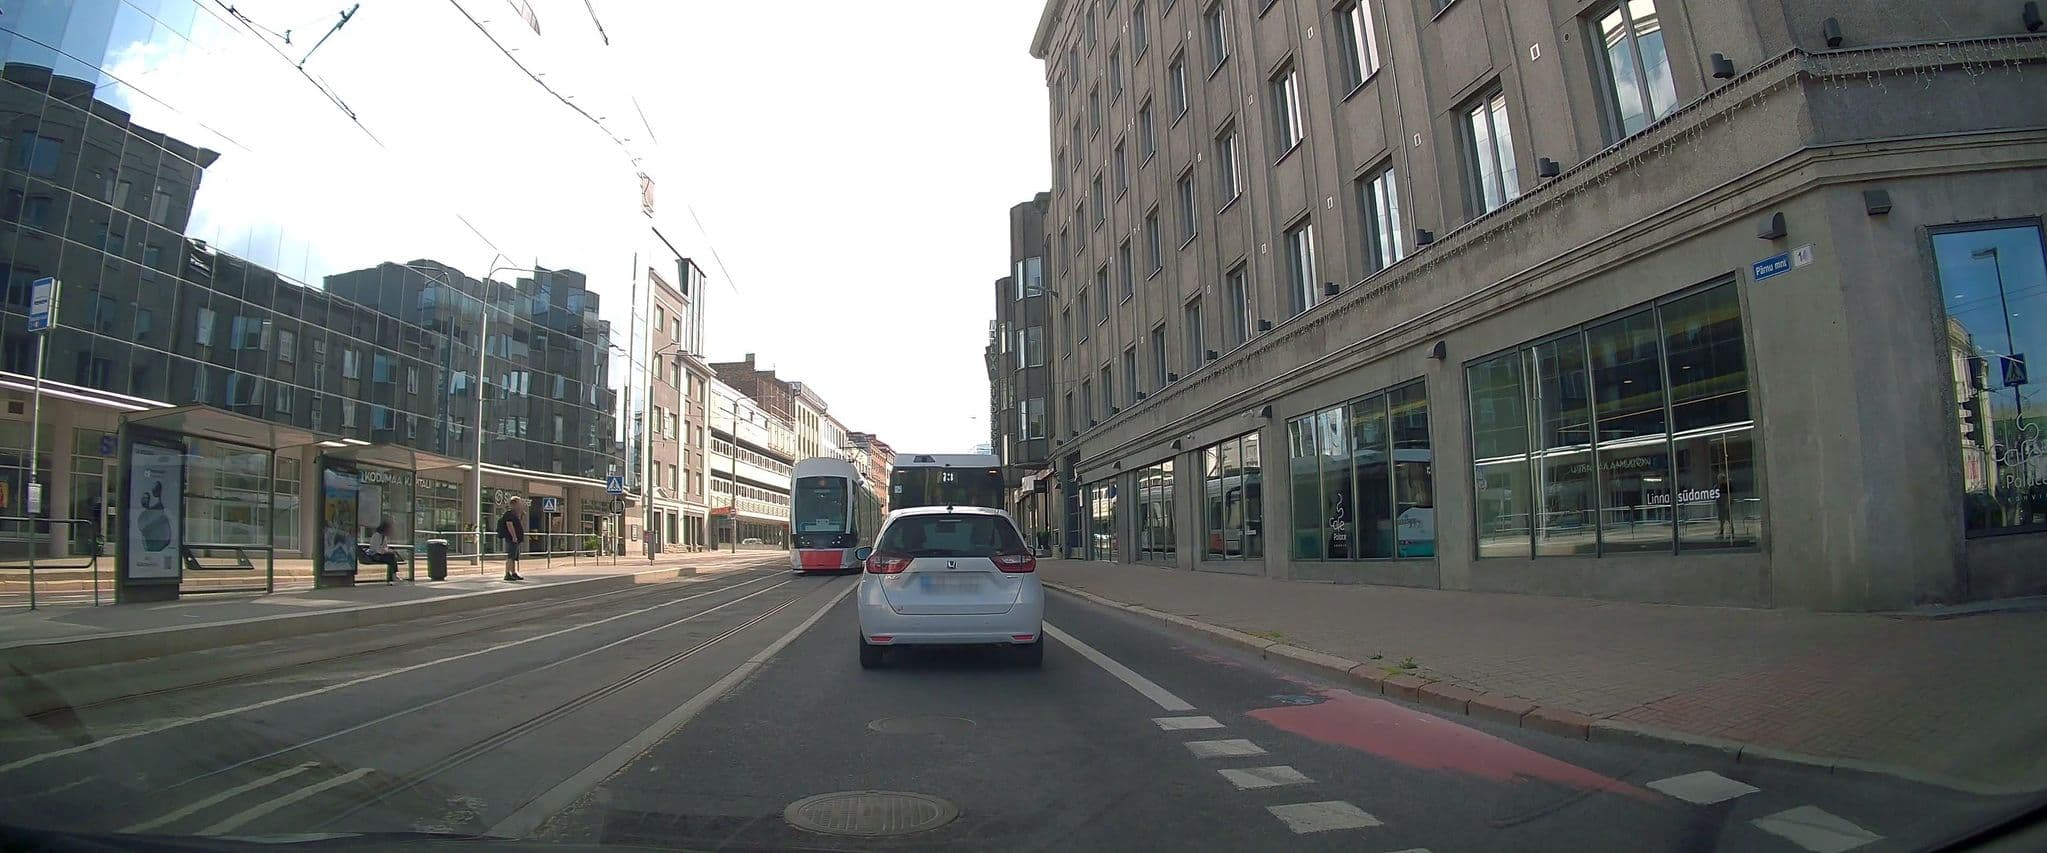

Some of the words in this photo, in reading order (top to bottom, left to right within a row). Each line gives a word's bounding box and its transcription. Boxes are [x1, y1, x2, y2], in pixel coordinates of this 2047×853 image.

[1755, 264, 1774, 276] Pärnu
[1774, 259, 1787, 270] mnt
[1646, 493, 1670, 505] Linna
